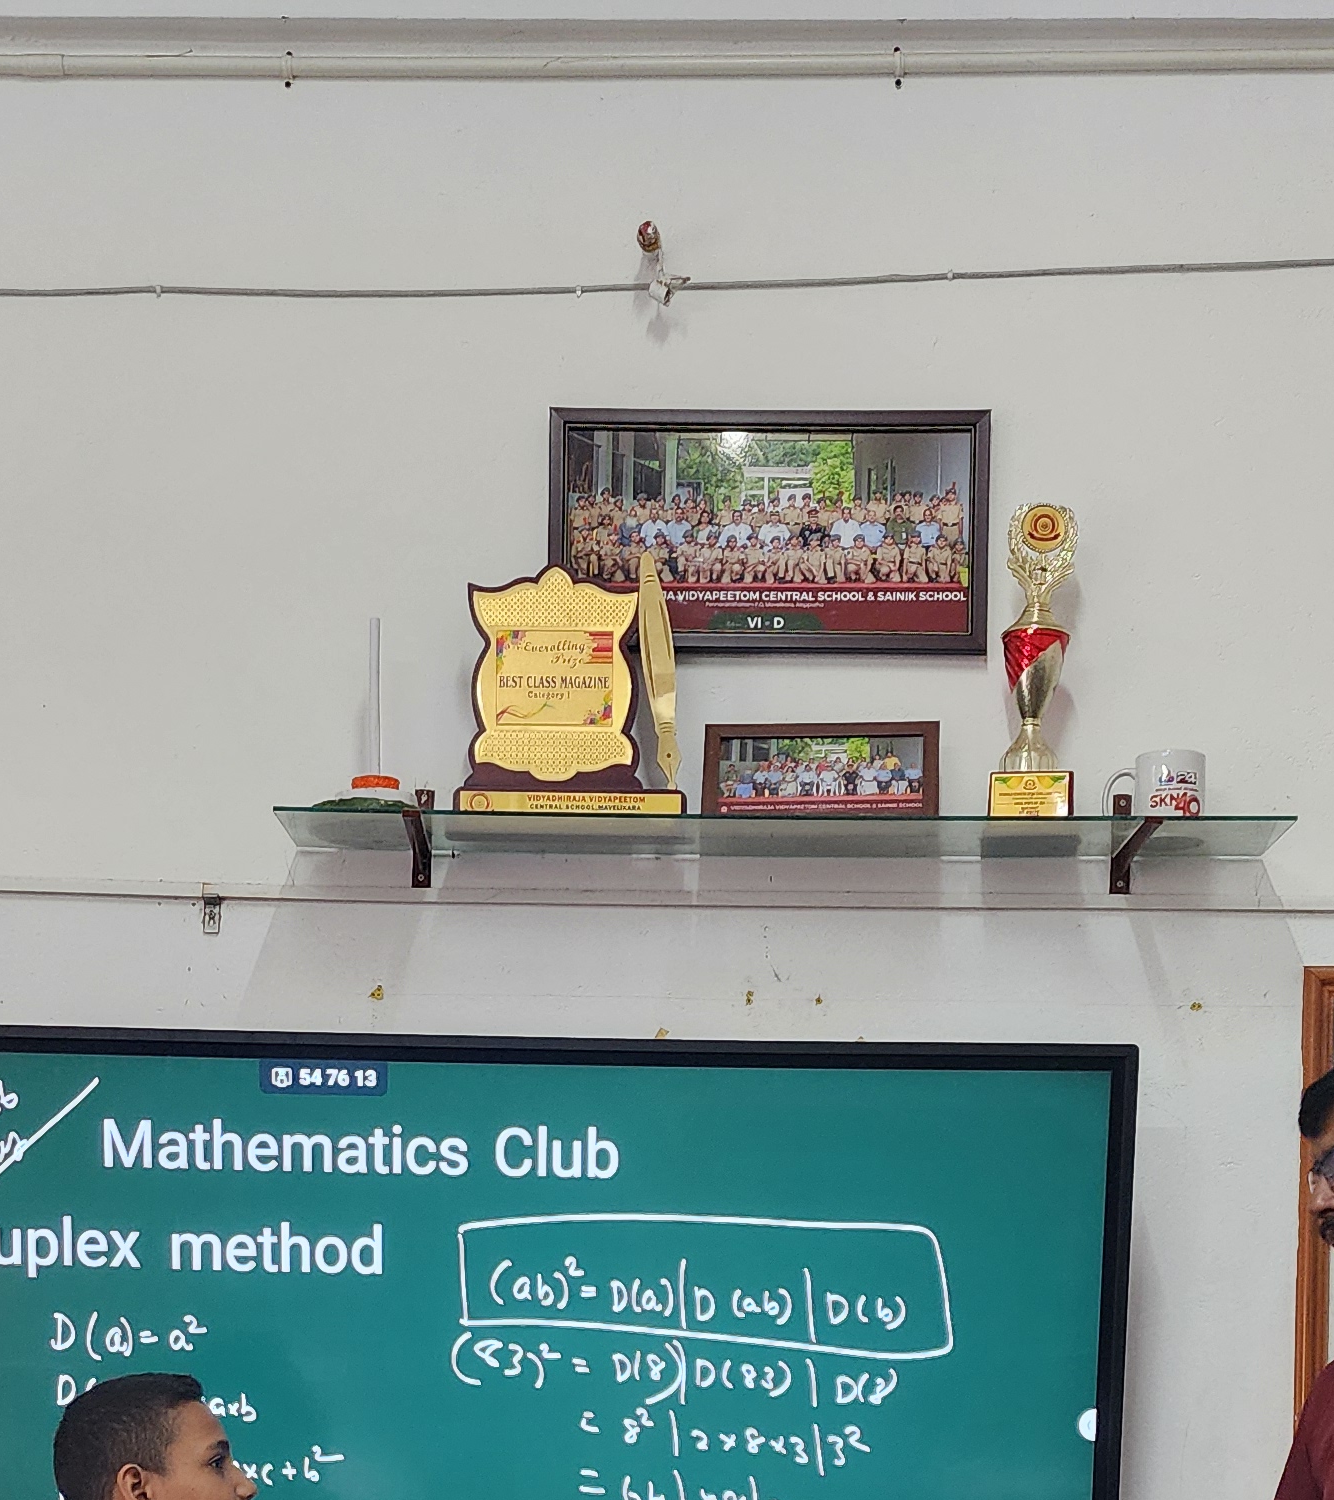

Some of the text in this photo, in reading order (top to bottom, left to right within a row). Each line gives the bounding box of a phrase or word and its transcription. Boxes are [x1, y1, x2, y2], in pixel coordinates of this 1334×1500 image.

[678, 590, 760, 602] VIDYAPEETOM
[761, 591, 815, 601] CENTRAL
[817, 591, 865, 602] SCHOOL
[867, 591, 875, 601] &
[877, 591, 917, 602] SAINIK
[919, 591, 967, 602] SCHOOL
[746, 616, 762, 629] VI
[773, 617, 785, 629] D
[498, 675, 610, 690] BEST CLASS MAGAZINE
[527, 690, 565, 700] Category
[527, 794, 646, 804] VIDYADHIRAJA VIDYAPEETOM
[298, 1067, 377, 1088] 54 76 13
[102, 1118, 620, 1179] Mathematics Club
[170, 1221, 384, 1275] method
